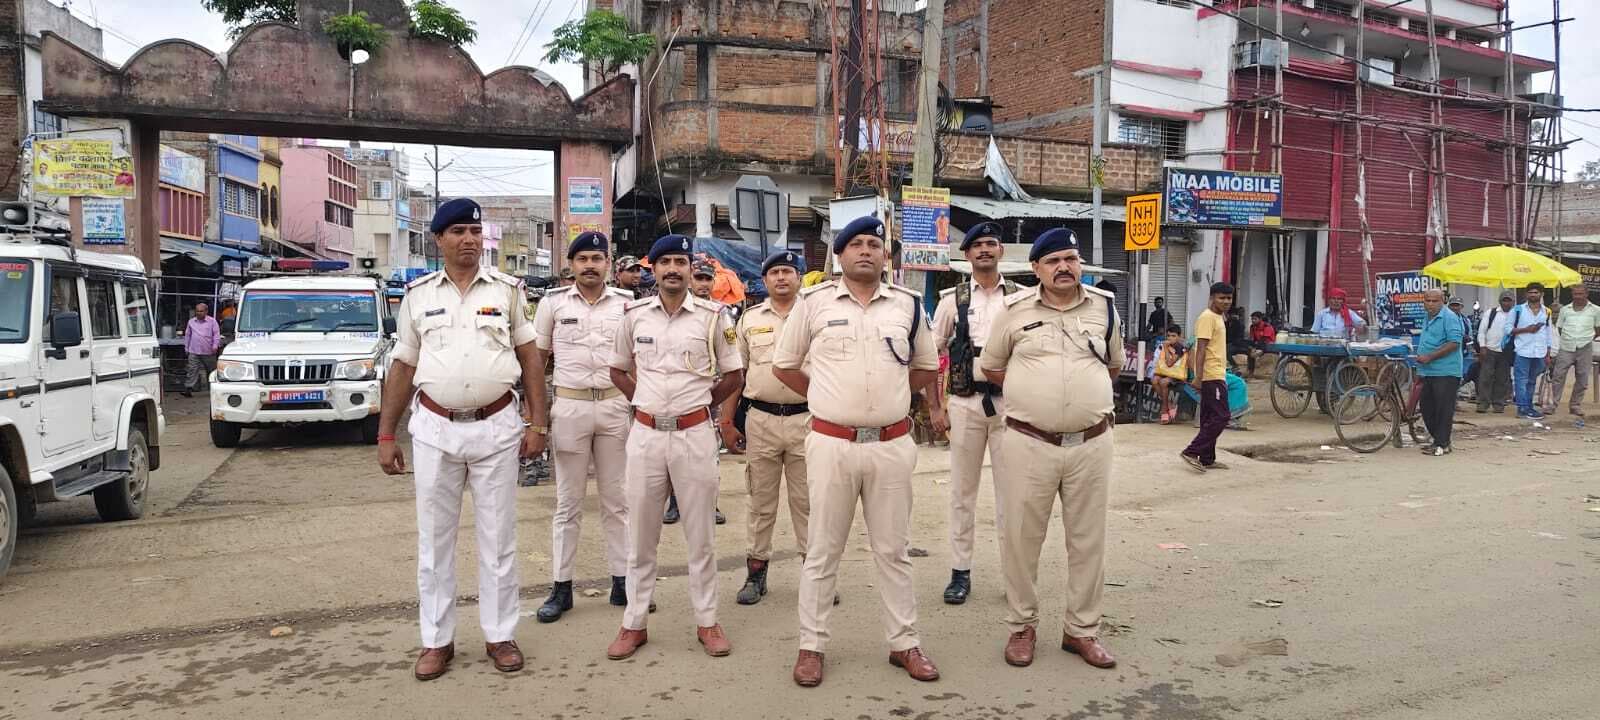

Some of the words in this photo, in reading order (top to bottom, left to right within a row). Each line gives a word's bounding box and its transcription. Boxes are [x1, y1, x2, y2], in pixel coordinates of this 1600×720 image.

[1172, 173, 1211, 190] MAA
[1215, 176, 1281, 193] MOBILE
[1133, 205, 1153, 219] NH
[1132, 223, 1153, 237] 333C
[1376, 278, 1401, 294] MAA
